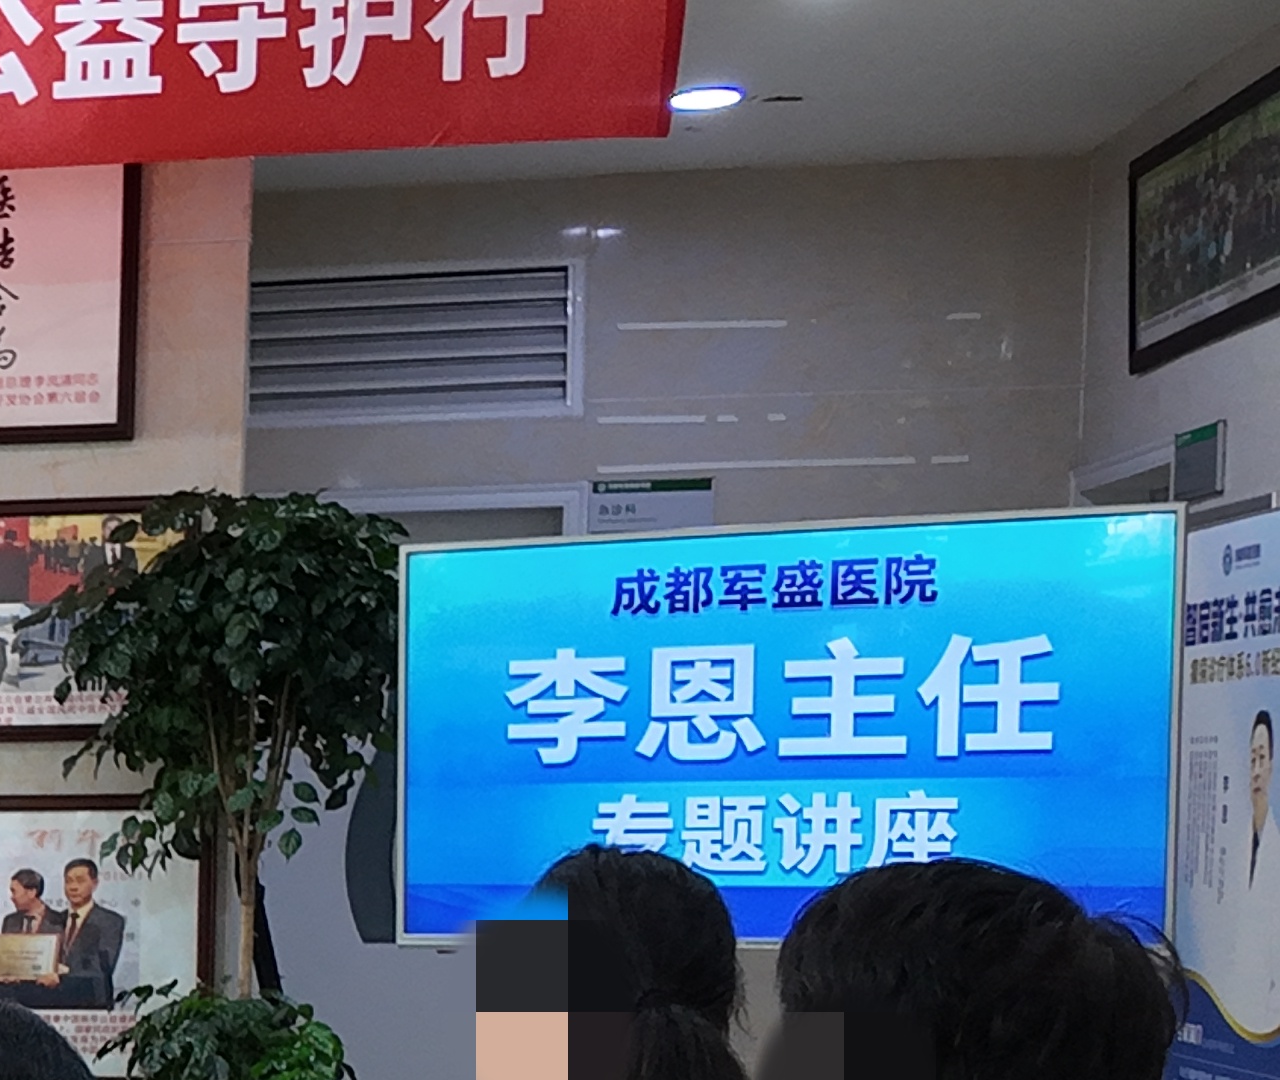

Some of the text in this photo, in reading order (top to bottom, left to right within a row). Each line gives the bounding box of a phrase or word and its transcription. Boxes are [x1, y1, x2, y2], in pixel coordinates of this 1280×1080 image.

[611, 553, 938, 617] 成都军盛医院
[505, 633, 1060, 766] 李恩主任
[592, 789, 958, 875] 专题讲座
